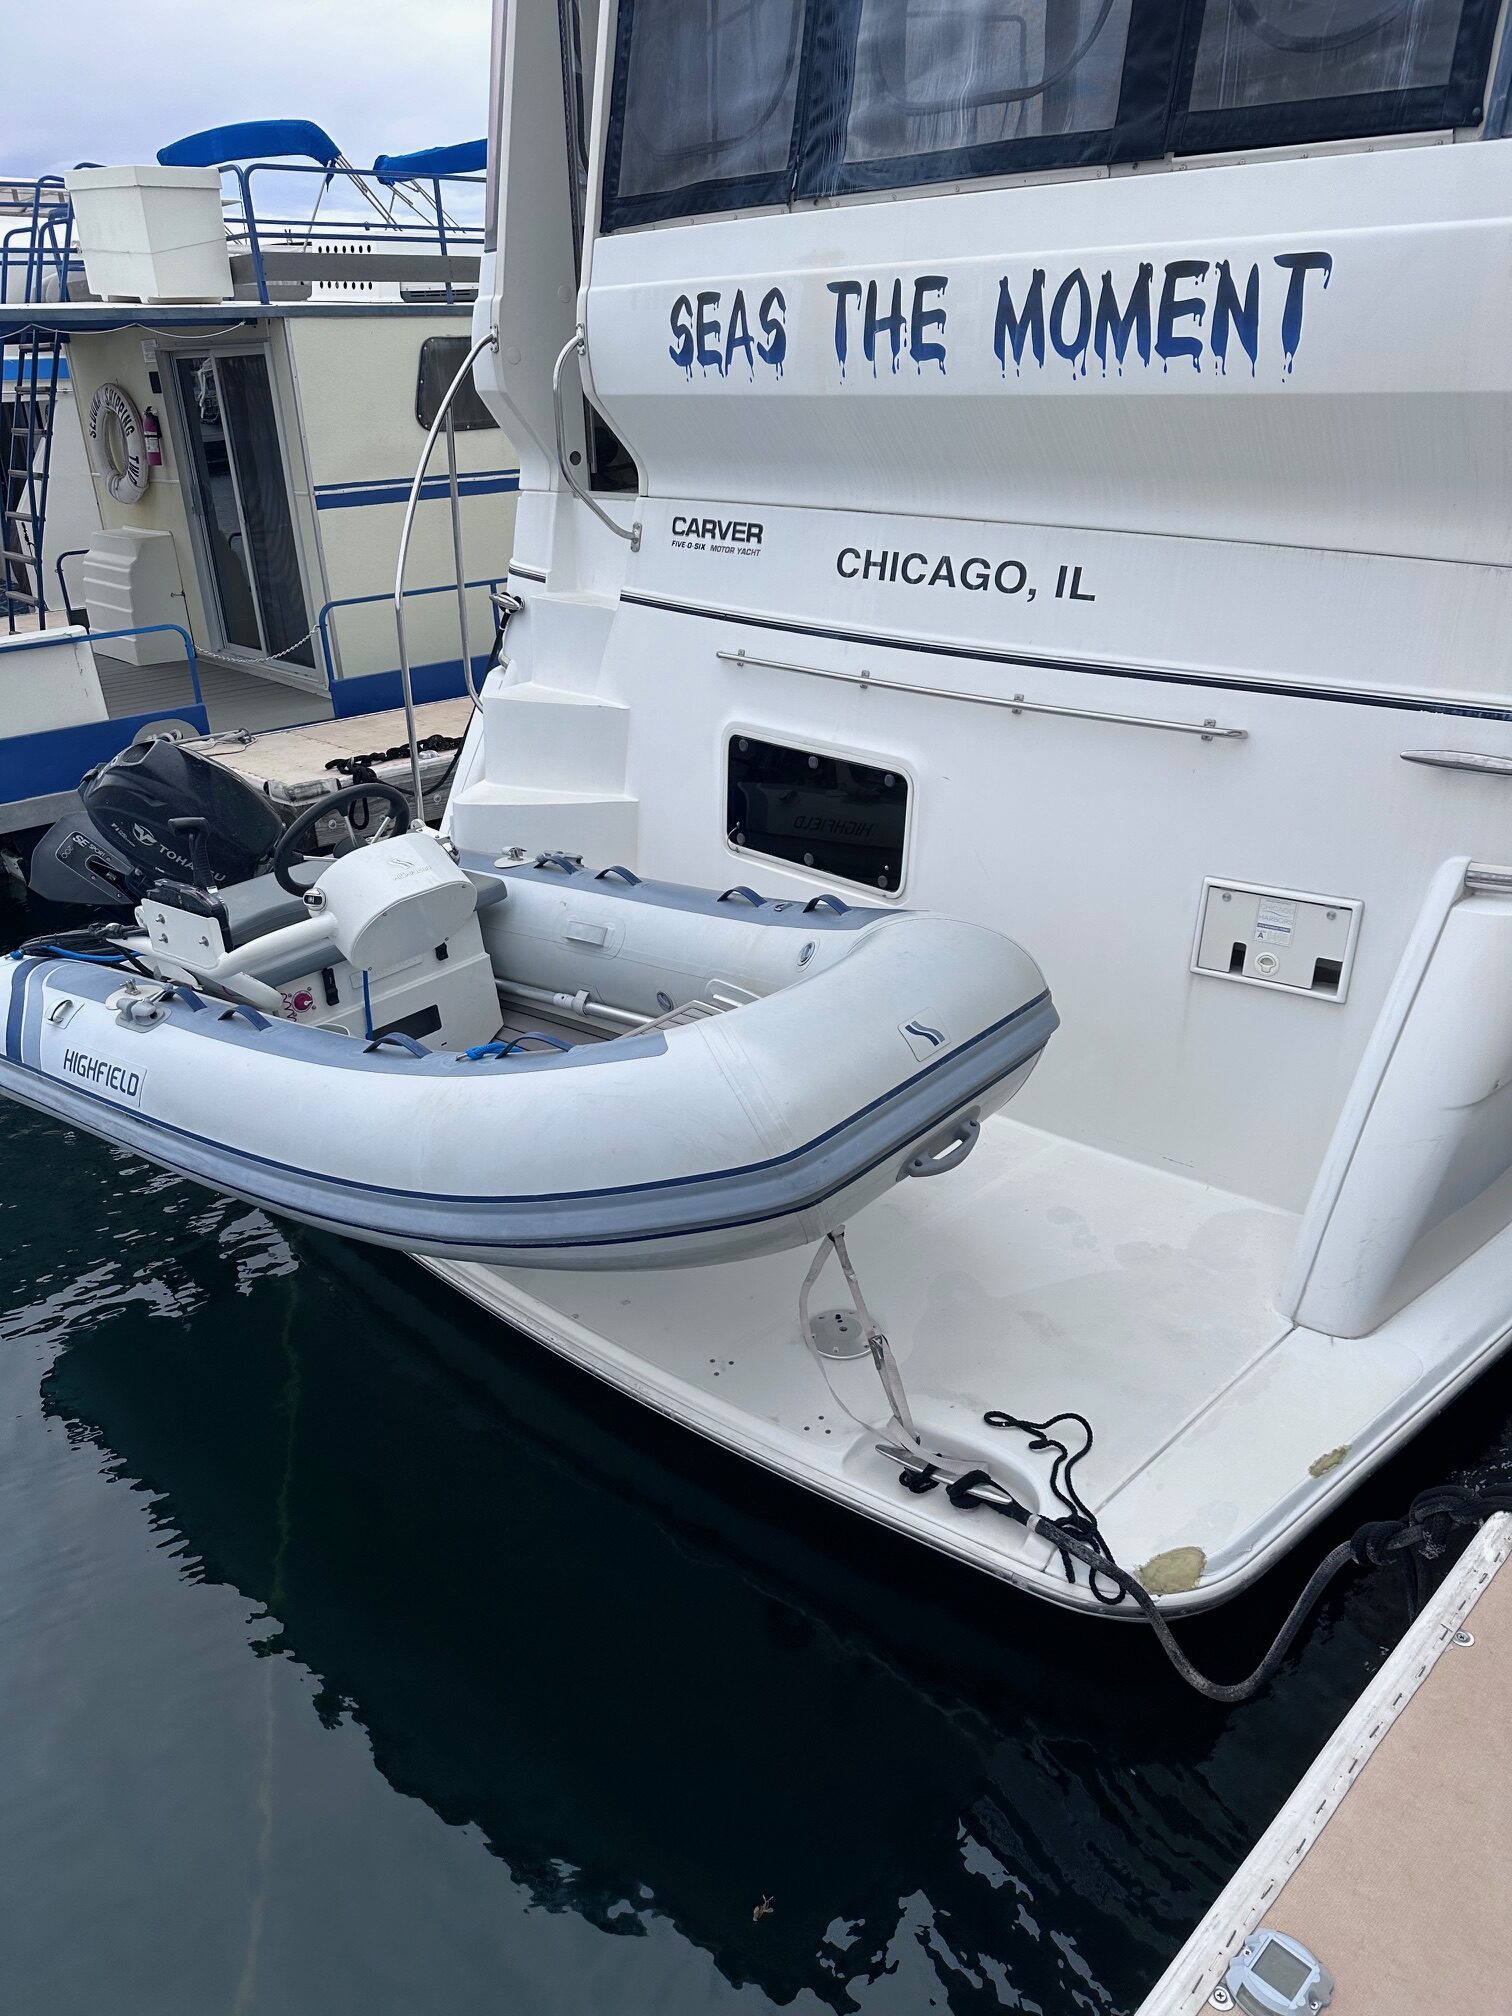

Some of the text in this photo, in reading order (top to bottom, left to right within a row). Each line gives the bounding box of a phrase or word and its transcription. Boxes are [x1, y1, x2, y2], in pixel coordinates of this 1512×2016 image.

[669, 251, 1333, 385] SEAS THE MOMENT
[672, 516, 764, 545] CARVER
[710, 544, 735, 554] MOTOR
[737, 547, 761, 557] YACHT
[836, 547, 1096, 603] CHICAGO, IL
[72, 834, 90, 848] SE
[159, 844, 226, 881] TOHAU
[63, 1048, 140, 1097] HIGHFIELD
